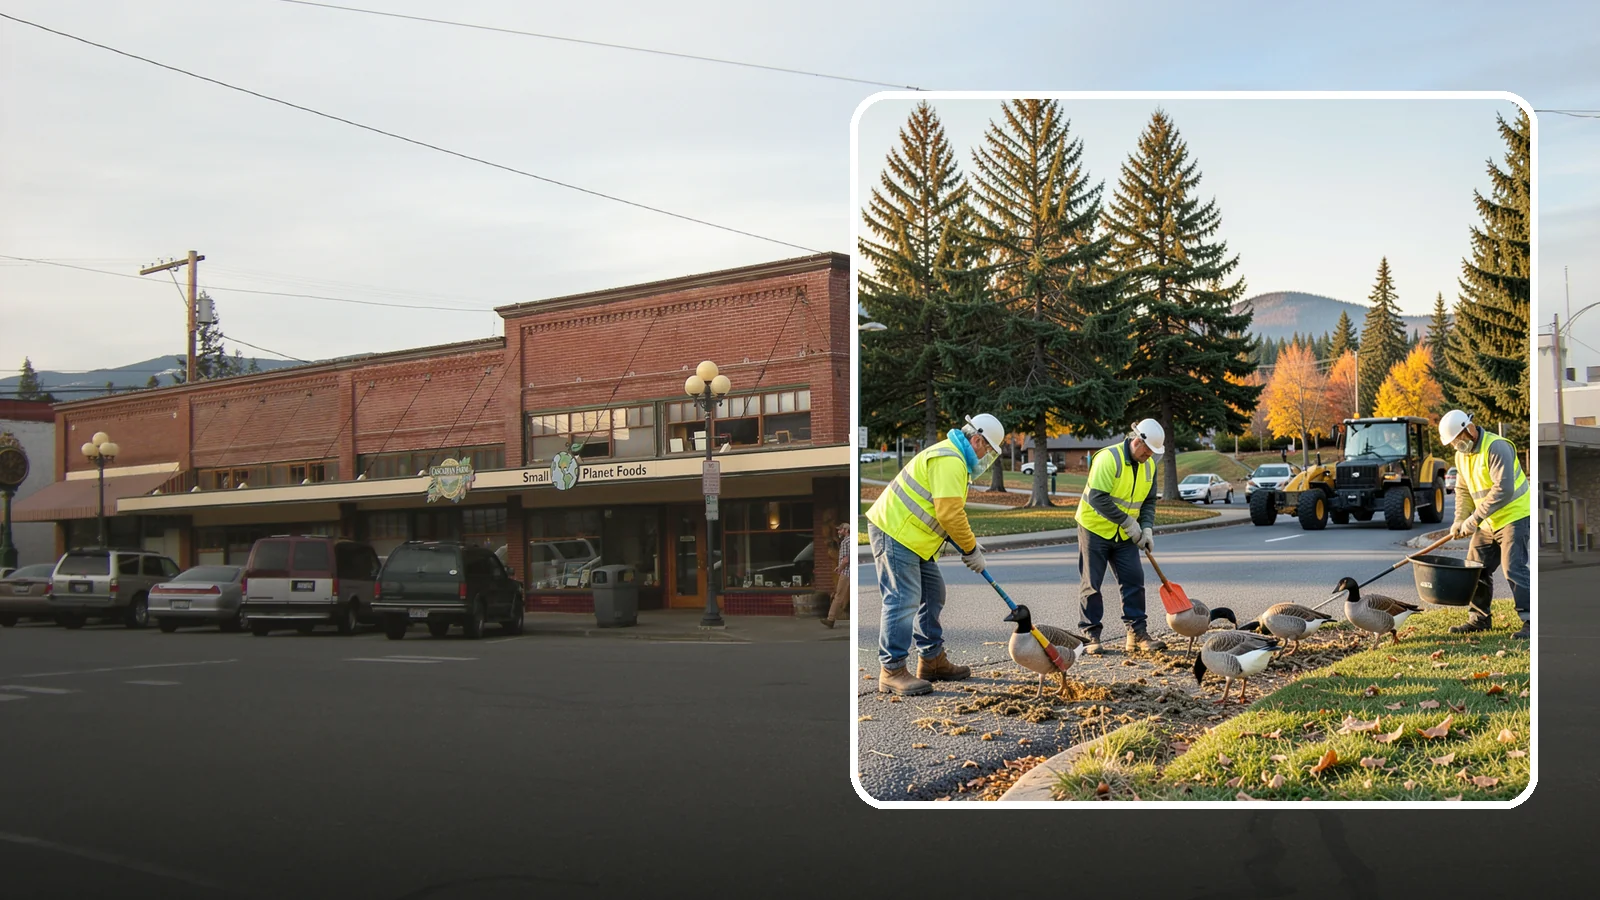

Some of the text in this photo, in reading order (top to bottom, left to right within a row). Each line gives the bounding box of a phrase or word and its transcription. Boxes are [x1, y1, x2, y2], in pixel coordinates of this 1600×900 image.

[523, 464, 647, 483] Small Planet Foods
